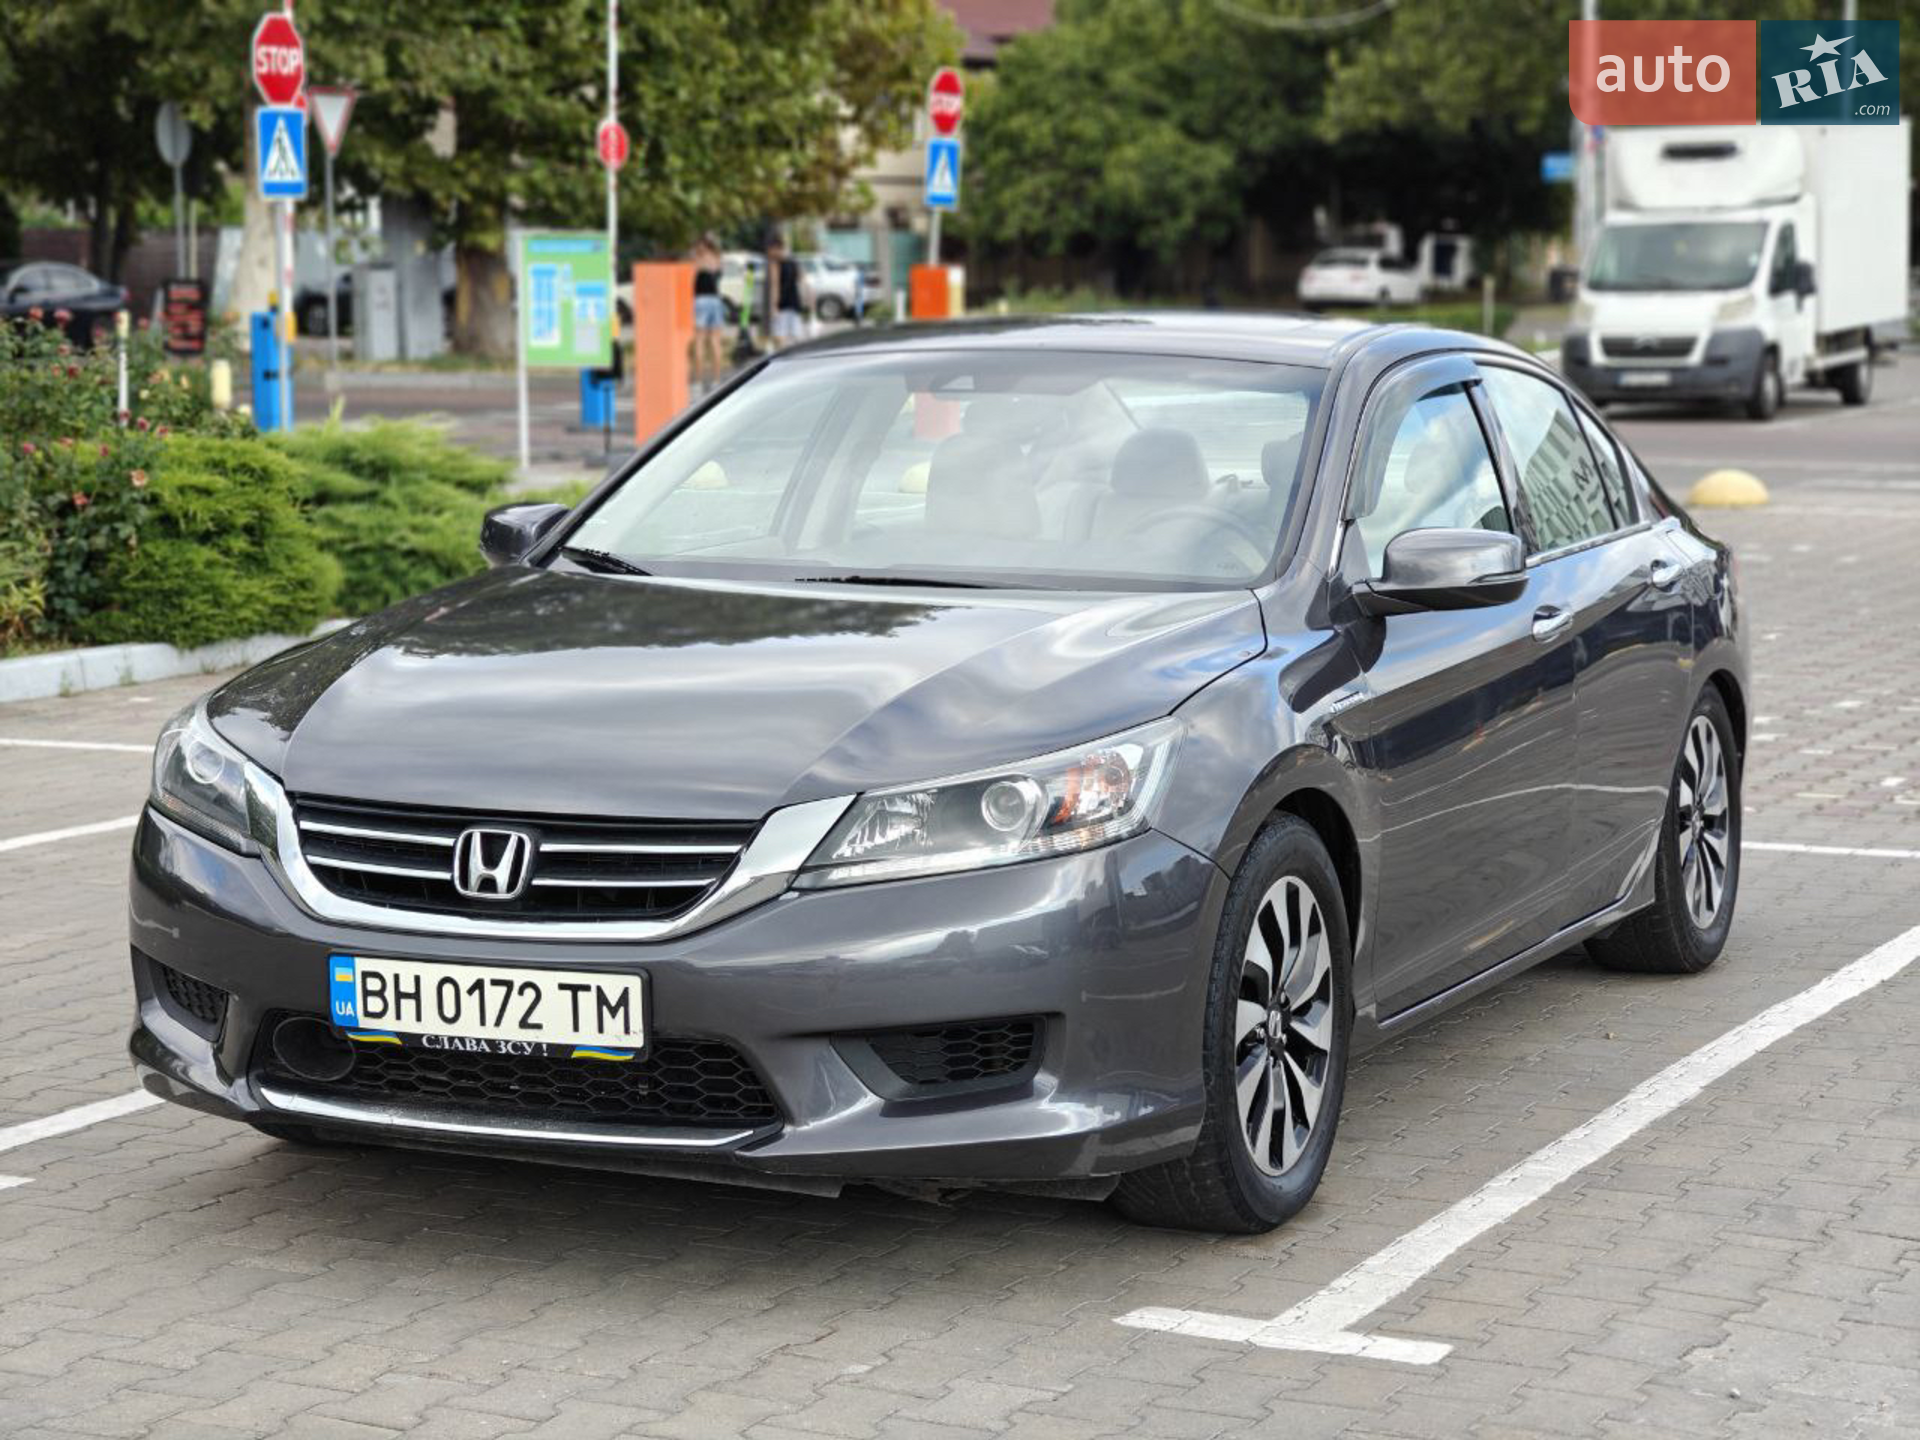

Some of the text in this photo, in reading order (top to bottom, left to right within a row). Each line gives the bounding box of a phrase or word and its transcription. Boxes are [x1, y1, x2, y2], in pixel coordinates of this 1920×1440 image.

[256, 45, 303, 75] STOP
[335, 1000, 355, 1017] UA
[360, 970, 631, 1035] BH 0172 TM
[421, 1034, 491, 1053] СЛАВА
[497, 1040, 535, 1056] ЗСУ
